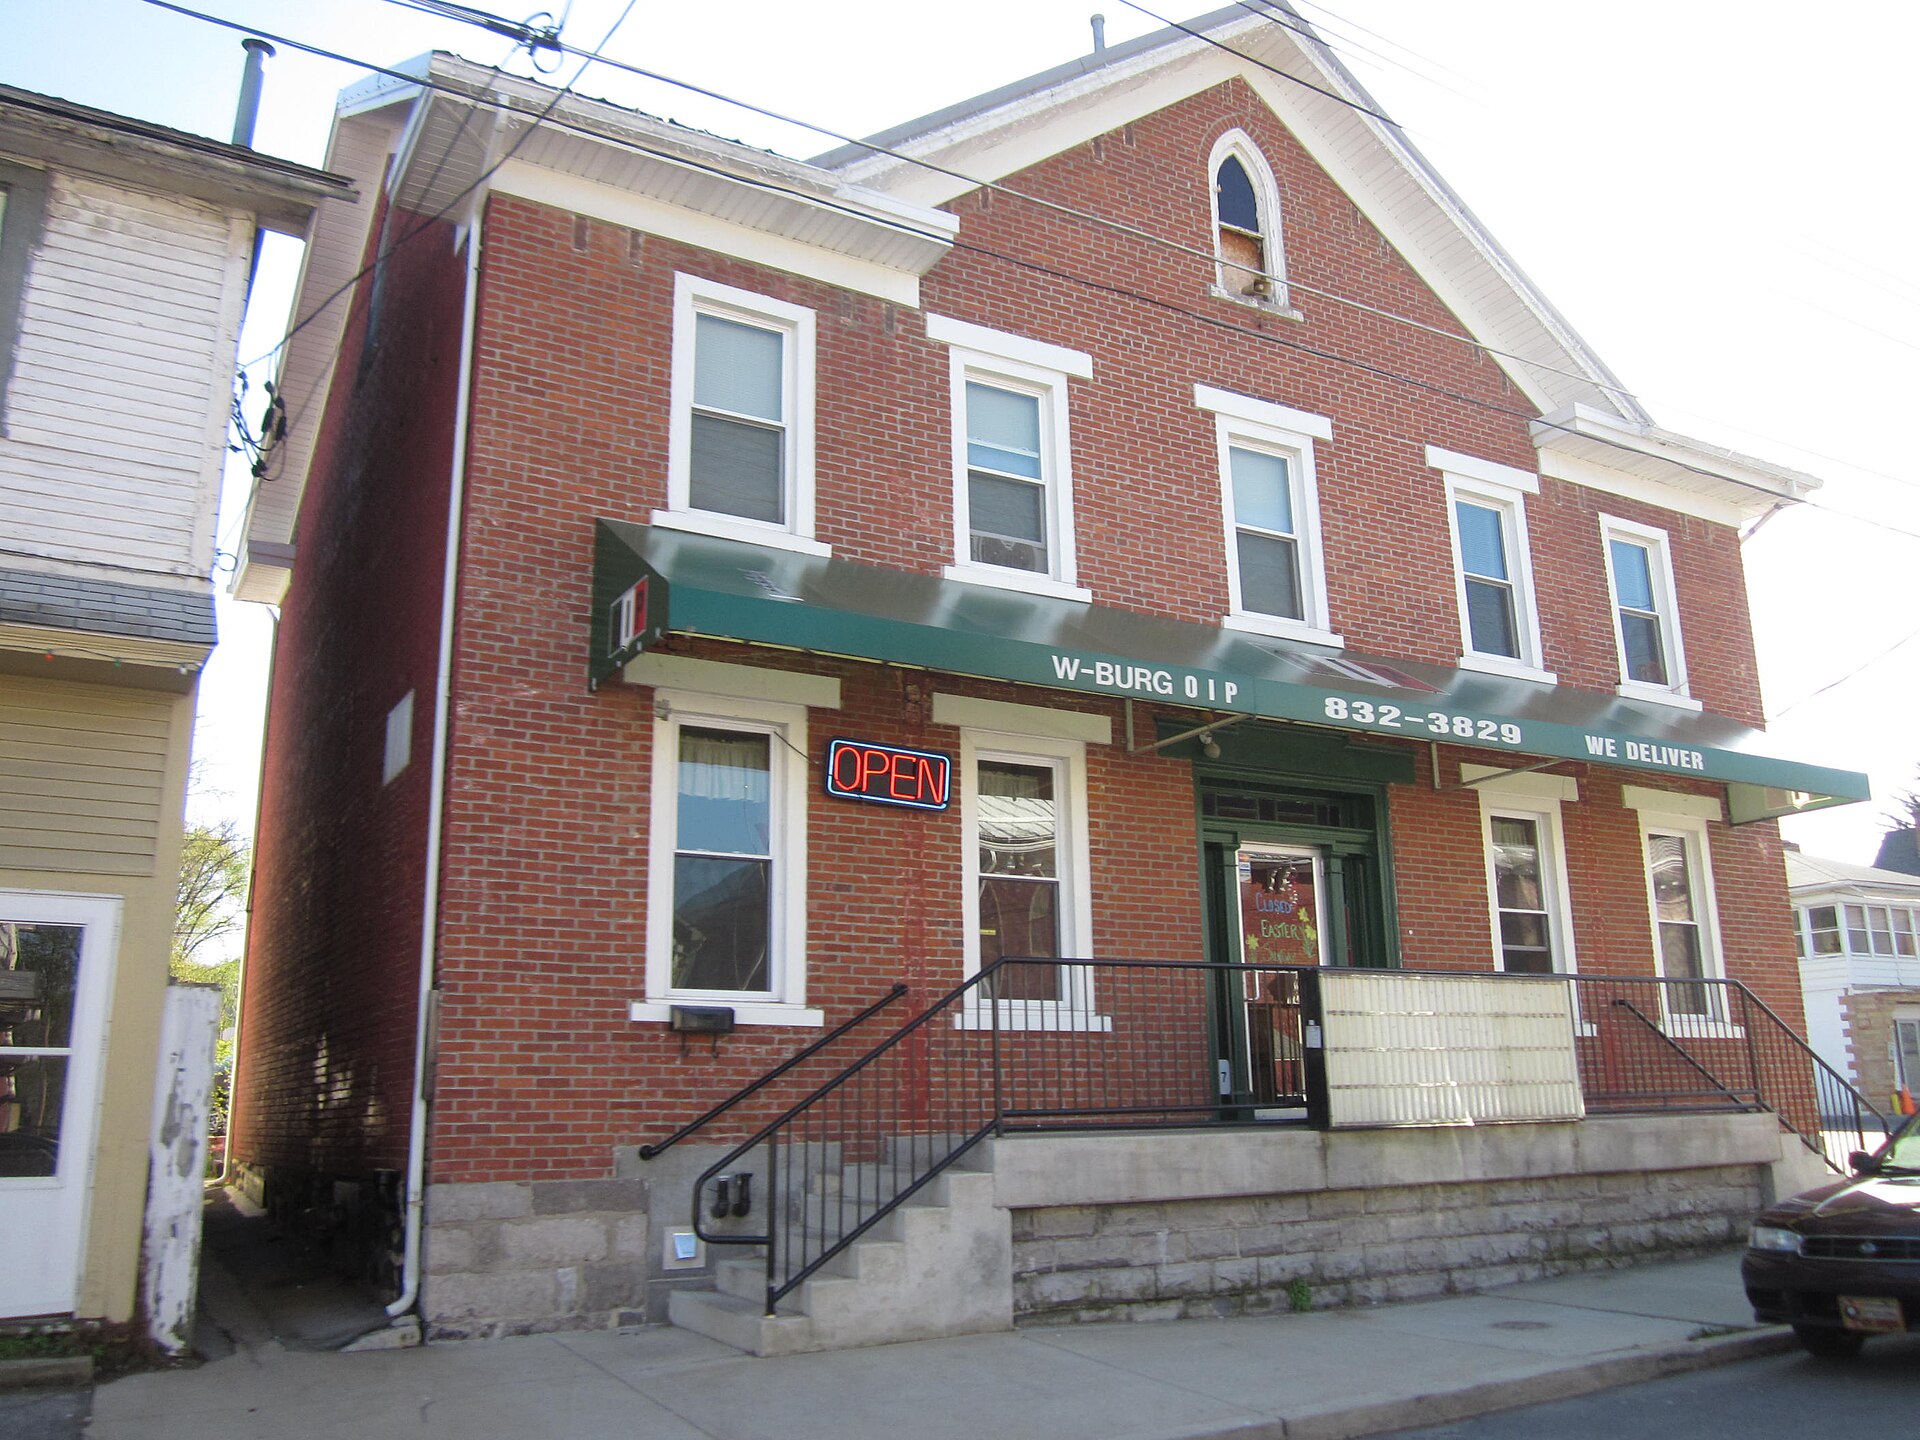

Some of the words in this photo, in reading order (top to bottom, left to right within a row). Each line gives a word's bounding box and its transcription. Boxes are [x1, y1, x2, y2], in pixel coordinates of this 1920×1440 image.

[1051, 655, 1173, 695] W-BURG
[1324, 696, 1522, 745] 832-3829
[1584, 734, 1618, 758] WE
[1625, 740, 1705, 771] DELIVER
[833, 745, 945, 804] OPEN
[1261, 919, 1301, 940] EASTER
